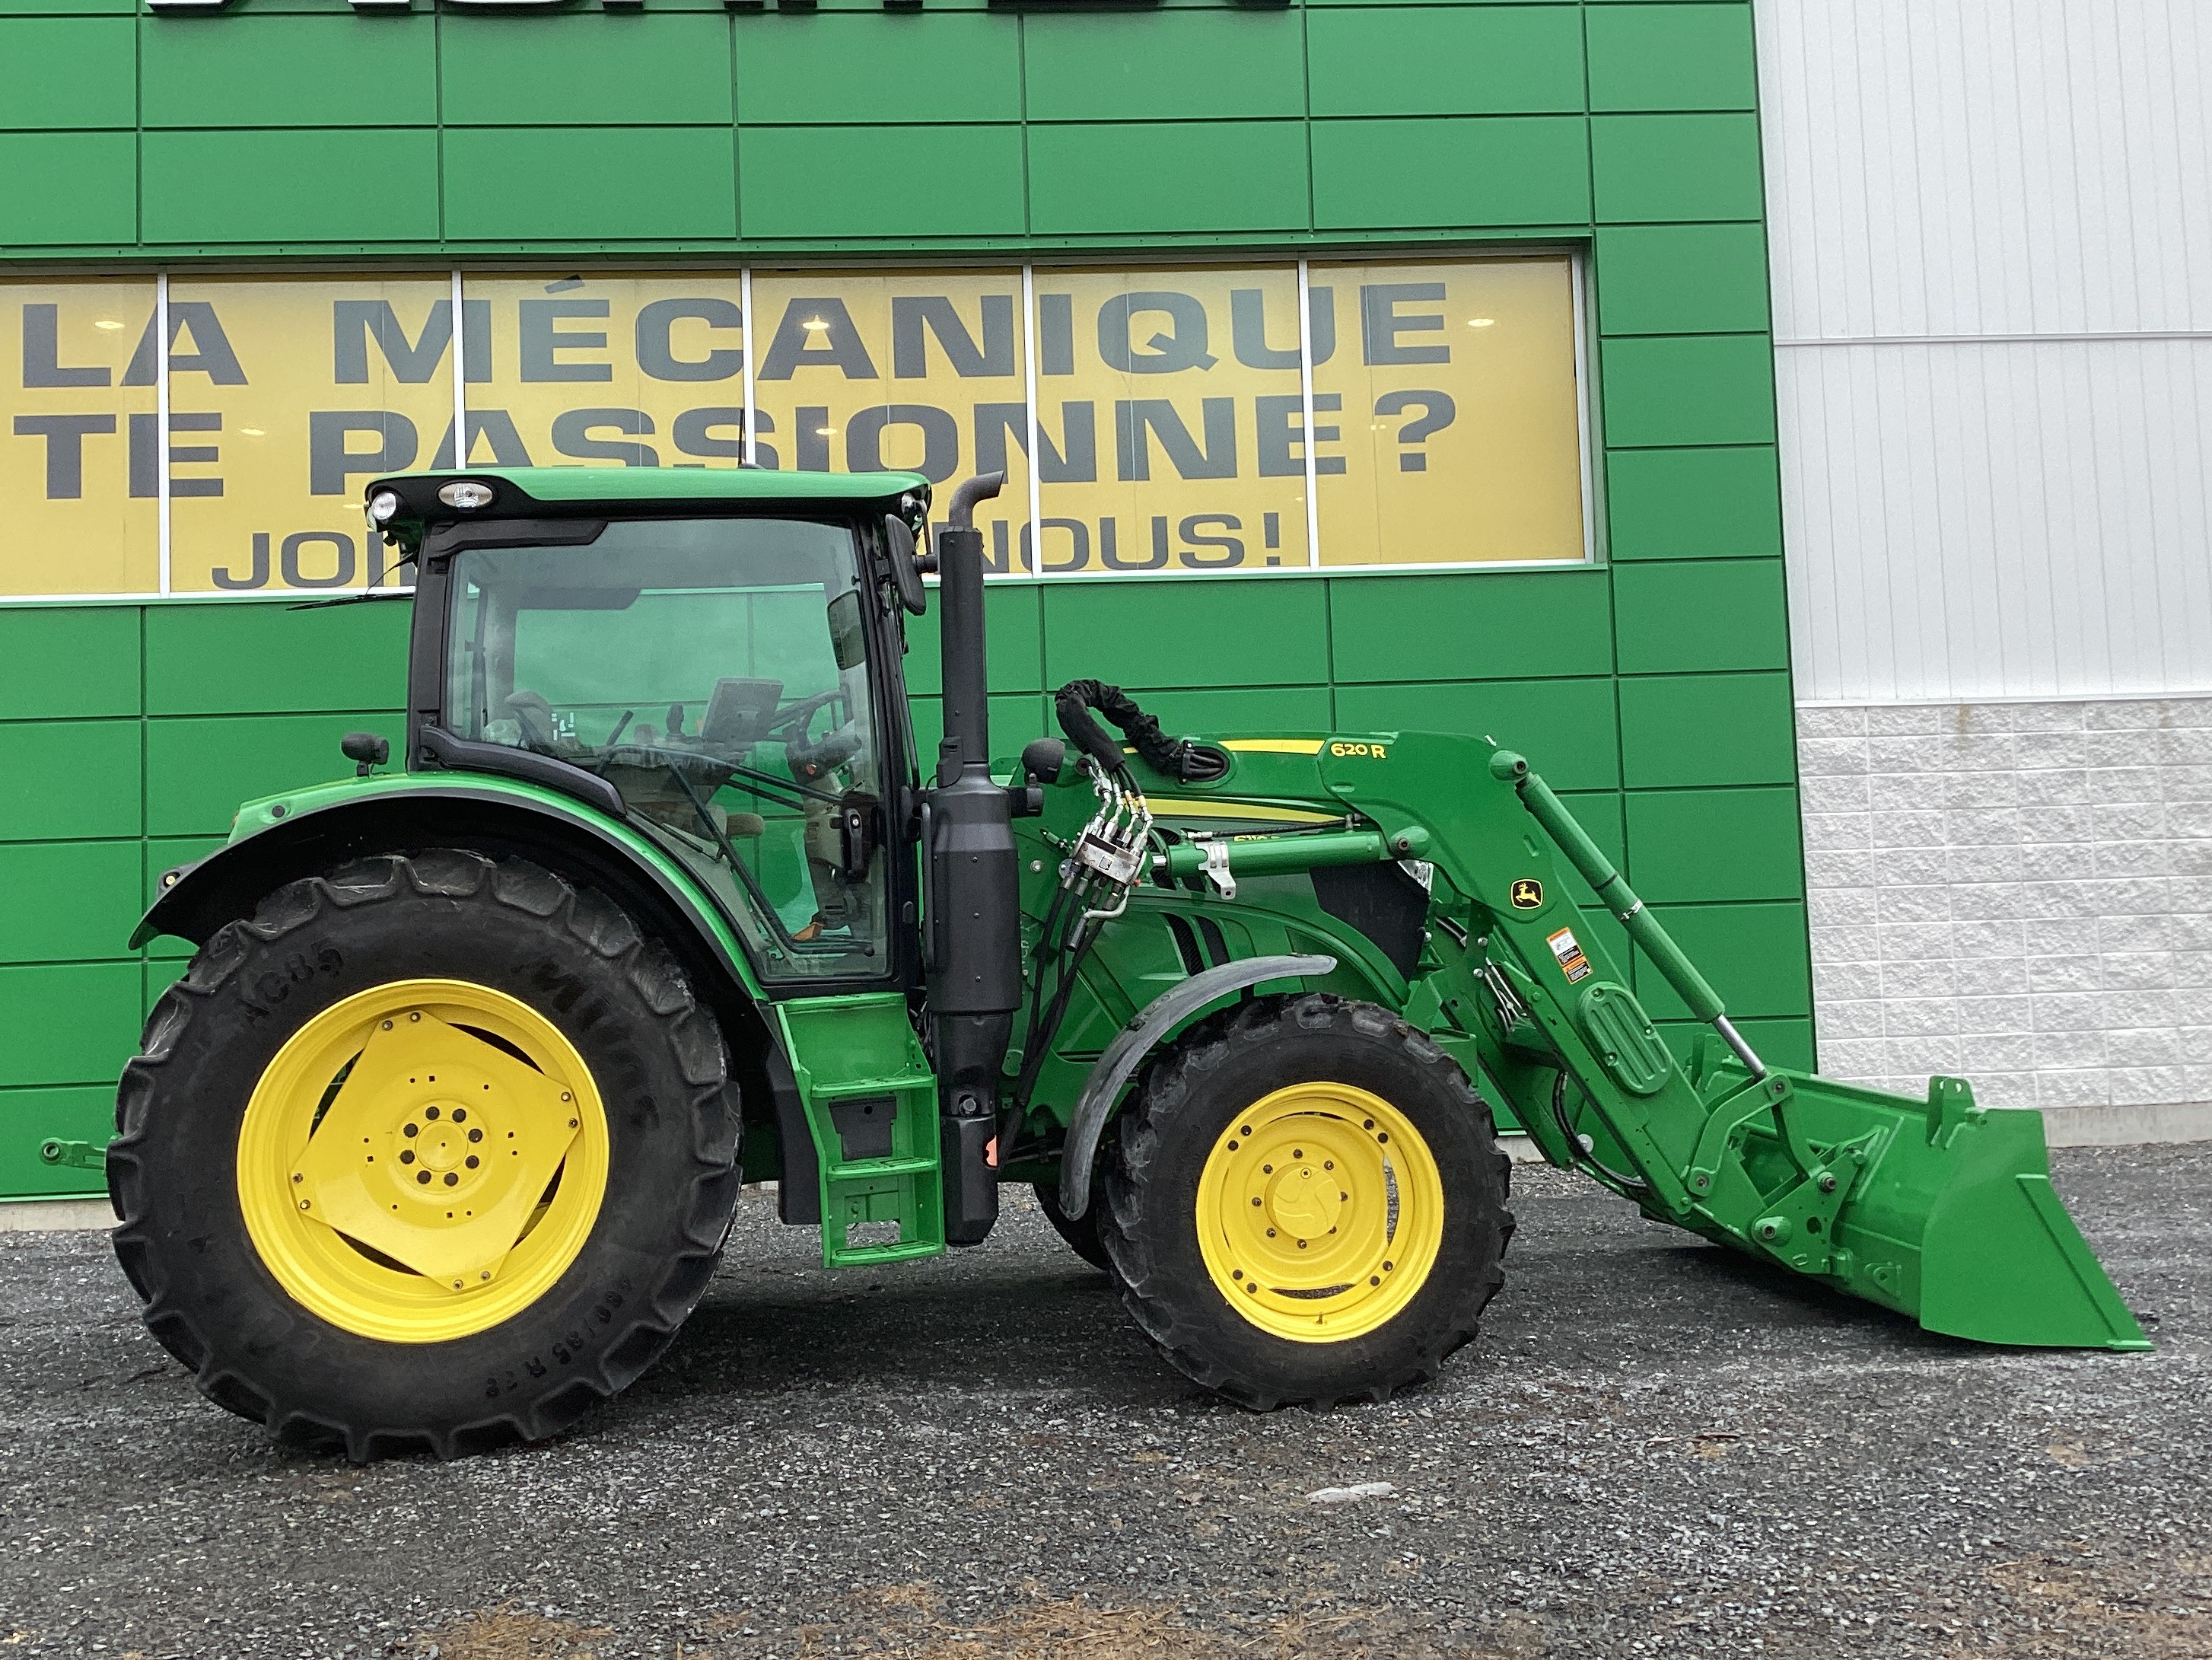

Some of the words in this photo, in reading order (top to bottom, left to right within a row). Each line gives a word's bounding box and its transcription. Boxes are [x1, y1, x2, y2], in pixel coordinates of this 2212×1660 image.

[23, 302, 249, 387] LA
[334, 275, 1450, 384] MÉCANIQUE
[14, 414, 224, 499] TE
